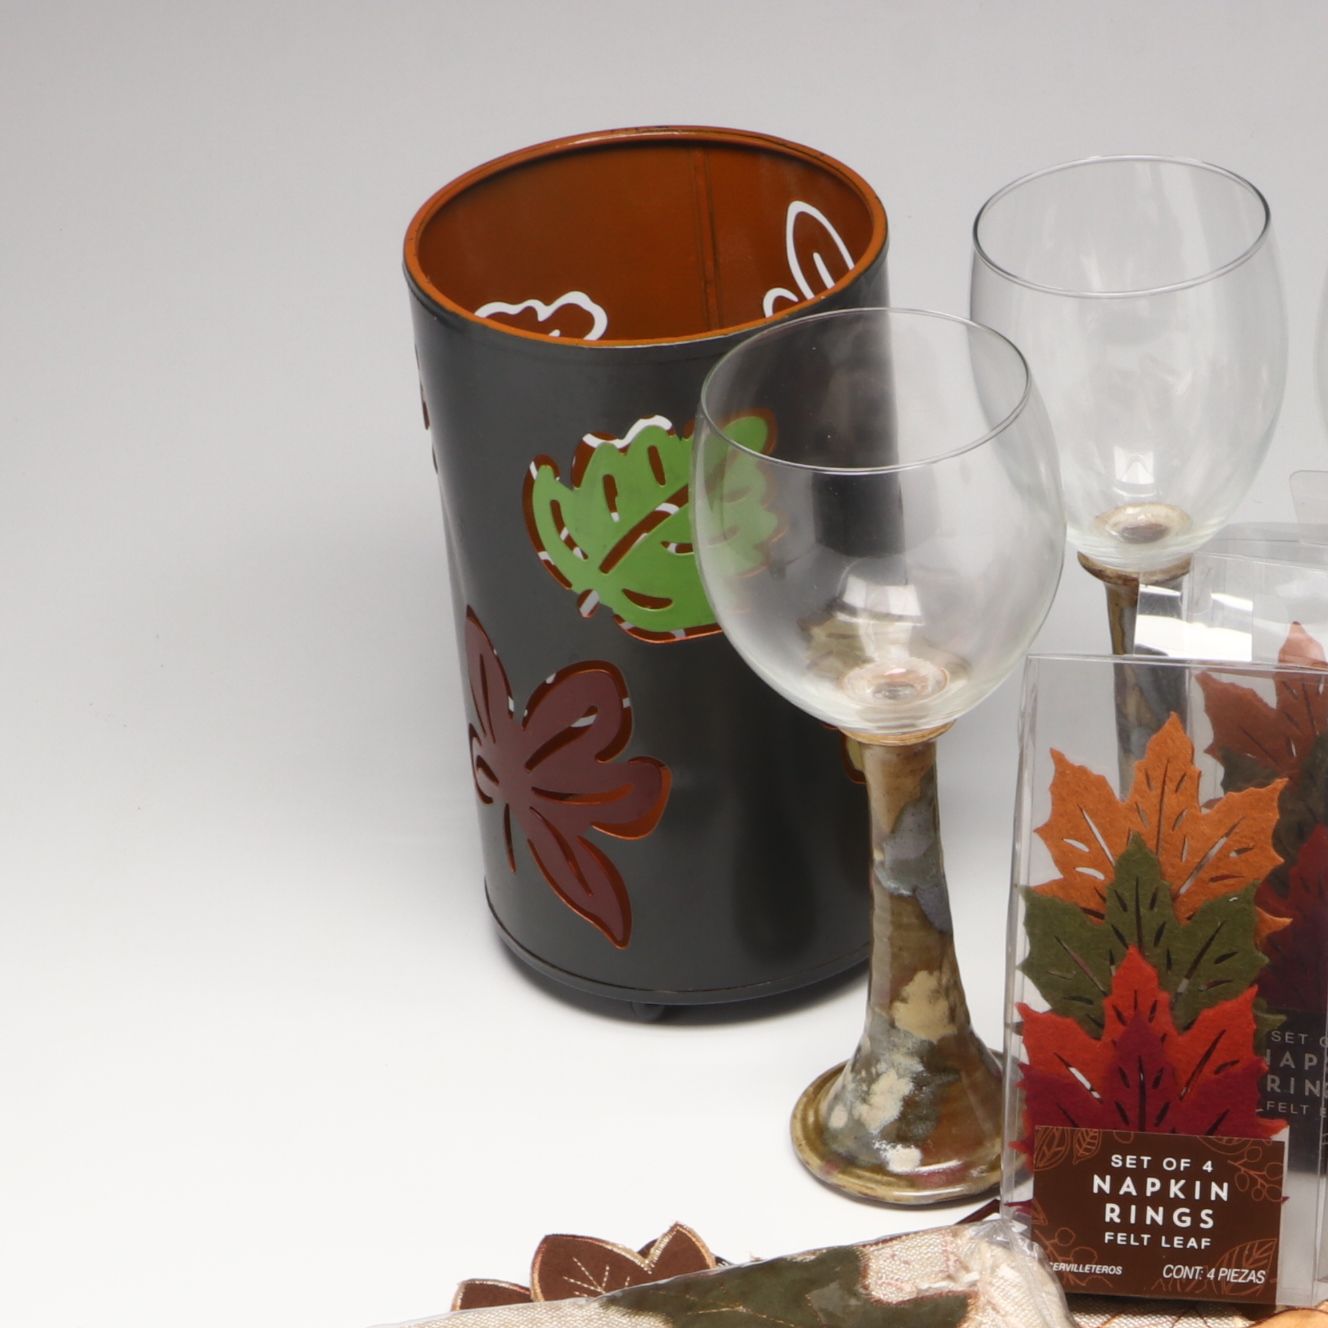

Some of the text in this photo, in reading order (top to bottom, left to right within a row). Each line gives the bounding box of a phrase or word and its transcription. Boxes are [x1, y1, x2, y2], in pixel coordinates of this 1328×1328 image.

[1271, 1030, 1309, 1045] SET
[1266, 1101, 1310, 1115] FELT
[1111, 1154, 1213, 1173] SET OF 4
[1092, 1175, 1229, 1202] NAPKIN
[1104, 1203, 1215, 1229] RINGS
[1104, 1232, 1212, 1250] FELT LEAF
[1162, 1264, 1266, 1285] CONT: 4 PIEZAS
